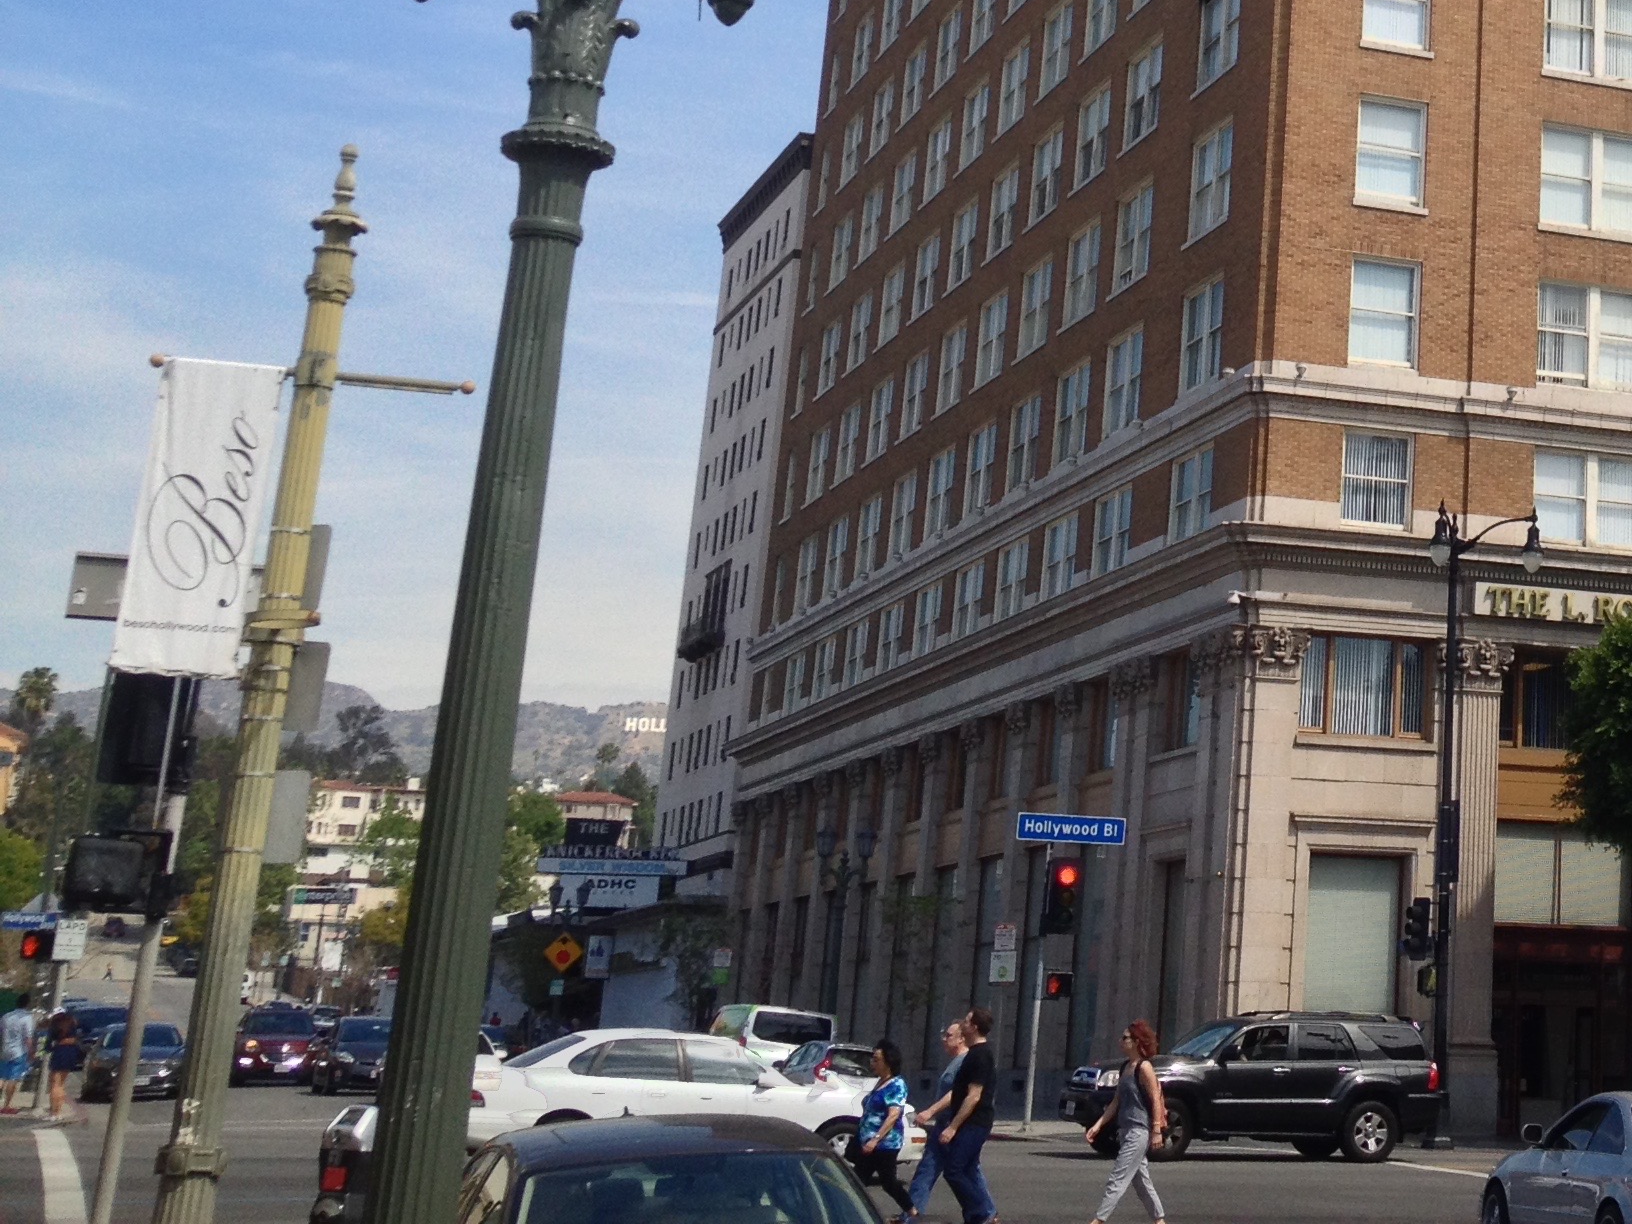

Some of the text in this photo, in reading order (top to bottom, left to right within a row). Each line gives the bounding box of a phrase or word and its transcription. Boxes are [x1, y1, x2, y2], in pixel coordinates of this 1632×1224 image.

[147, 410, 258, 608] Beso
[1485, 586, 1550, 620] THE
[579, 822, 609, 834] THE
[1024, 818, 1118, 837] Hollywood Bl
